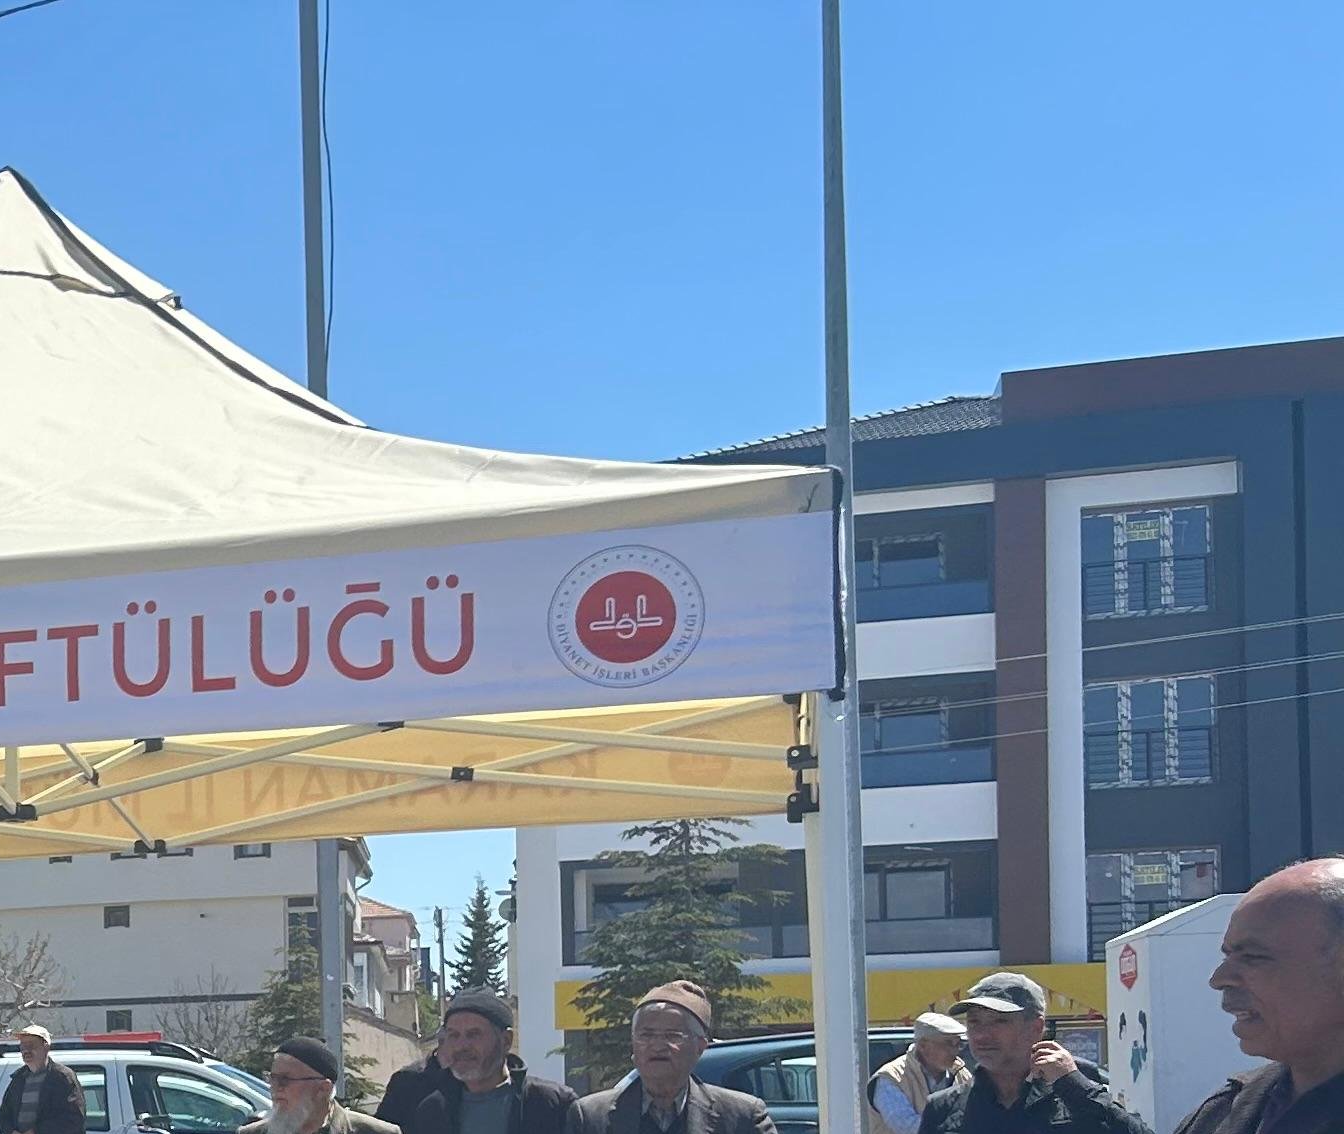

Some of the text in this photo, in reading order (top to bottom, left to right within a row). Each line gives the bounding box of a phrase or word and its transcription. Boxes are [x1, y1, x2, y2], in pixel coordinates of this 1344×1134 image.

[556, 613, 698, 681] DİYANET İŞLERİ BAŞKANLIĞI
